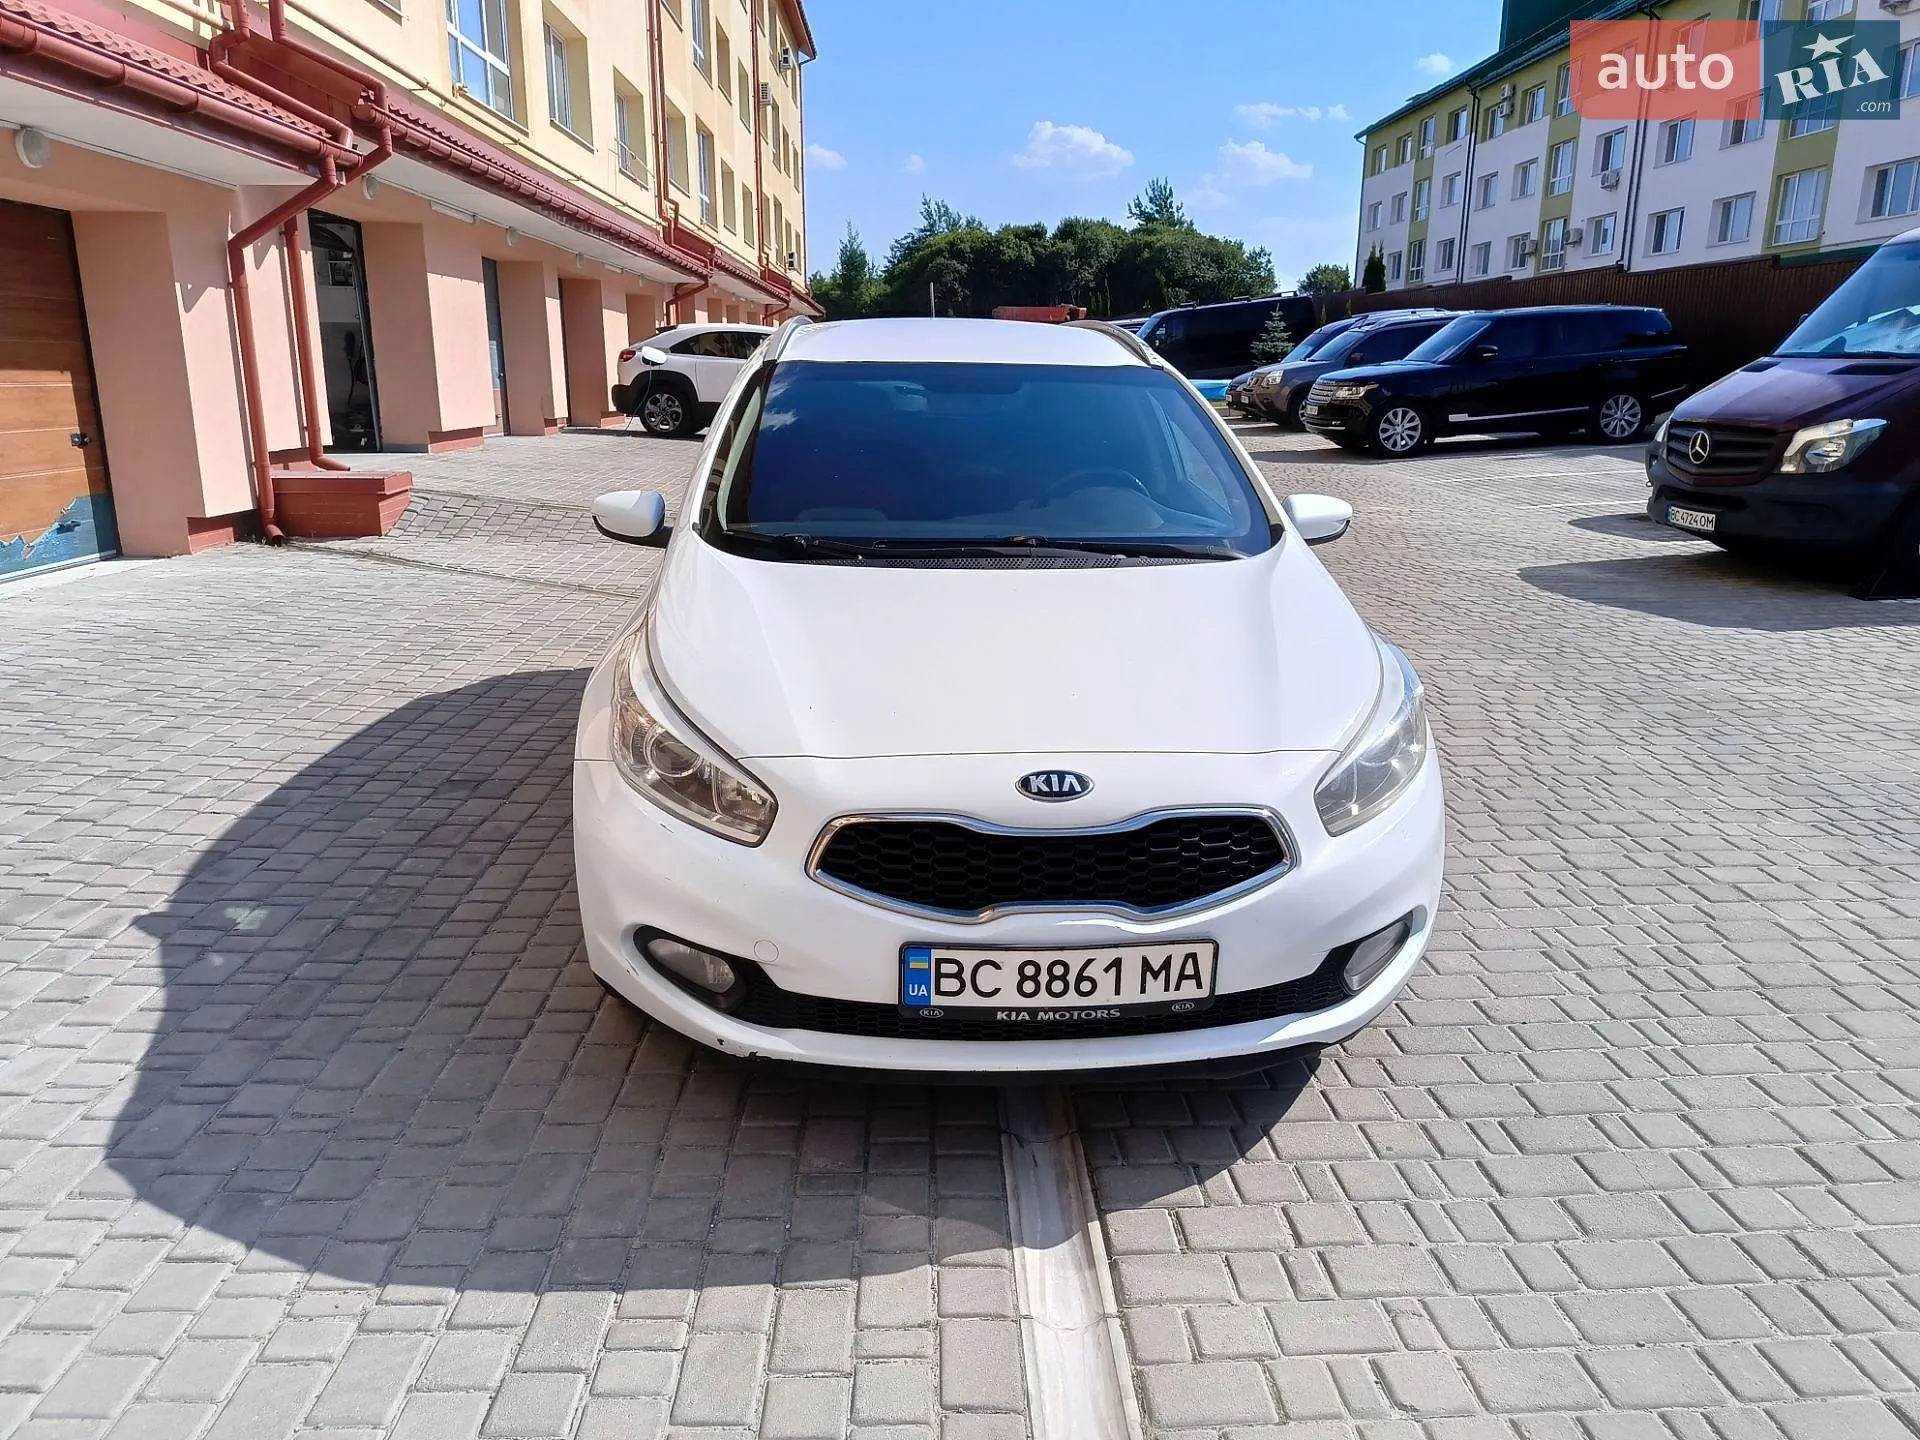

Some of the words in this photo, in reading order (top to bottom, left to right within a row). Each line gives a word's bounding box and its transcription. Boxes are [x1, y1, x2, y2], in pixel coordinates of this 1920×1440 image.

[1671, 508, 1680, 522] BC
[1680, 511, 1698, 526] 4724
[1699, 515, 1715, 529] OM
[1028, 774, 1082, 793] KIA
[934, 957, 1002, 998] BC
[1016, 957, 1123, 998] 8861
[1139, 952, 1203, 995] MA
[909, 983, 928, 997] UA
[996, 1010, 1031, 1021] KIA
[1036, 1008, 1121, 1021] MOTORS
